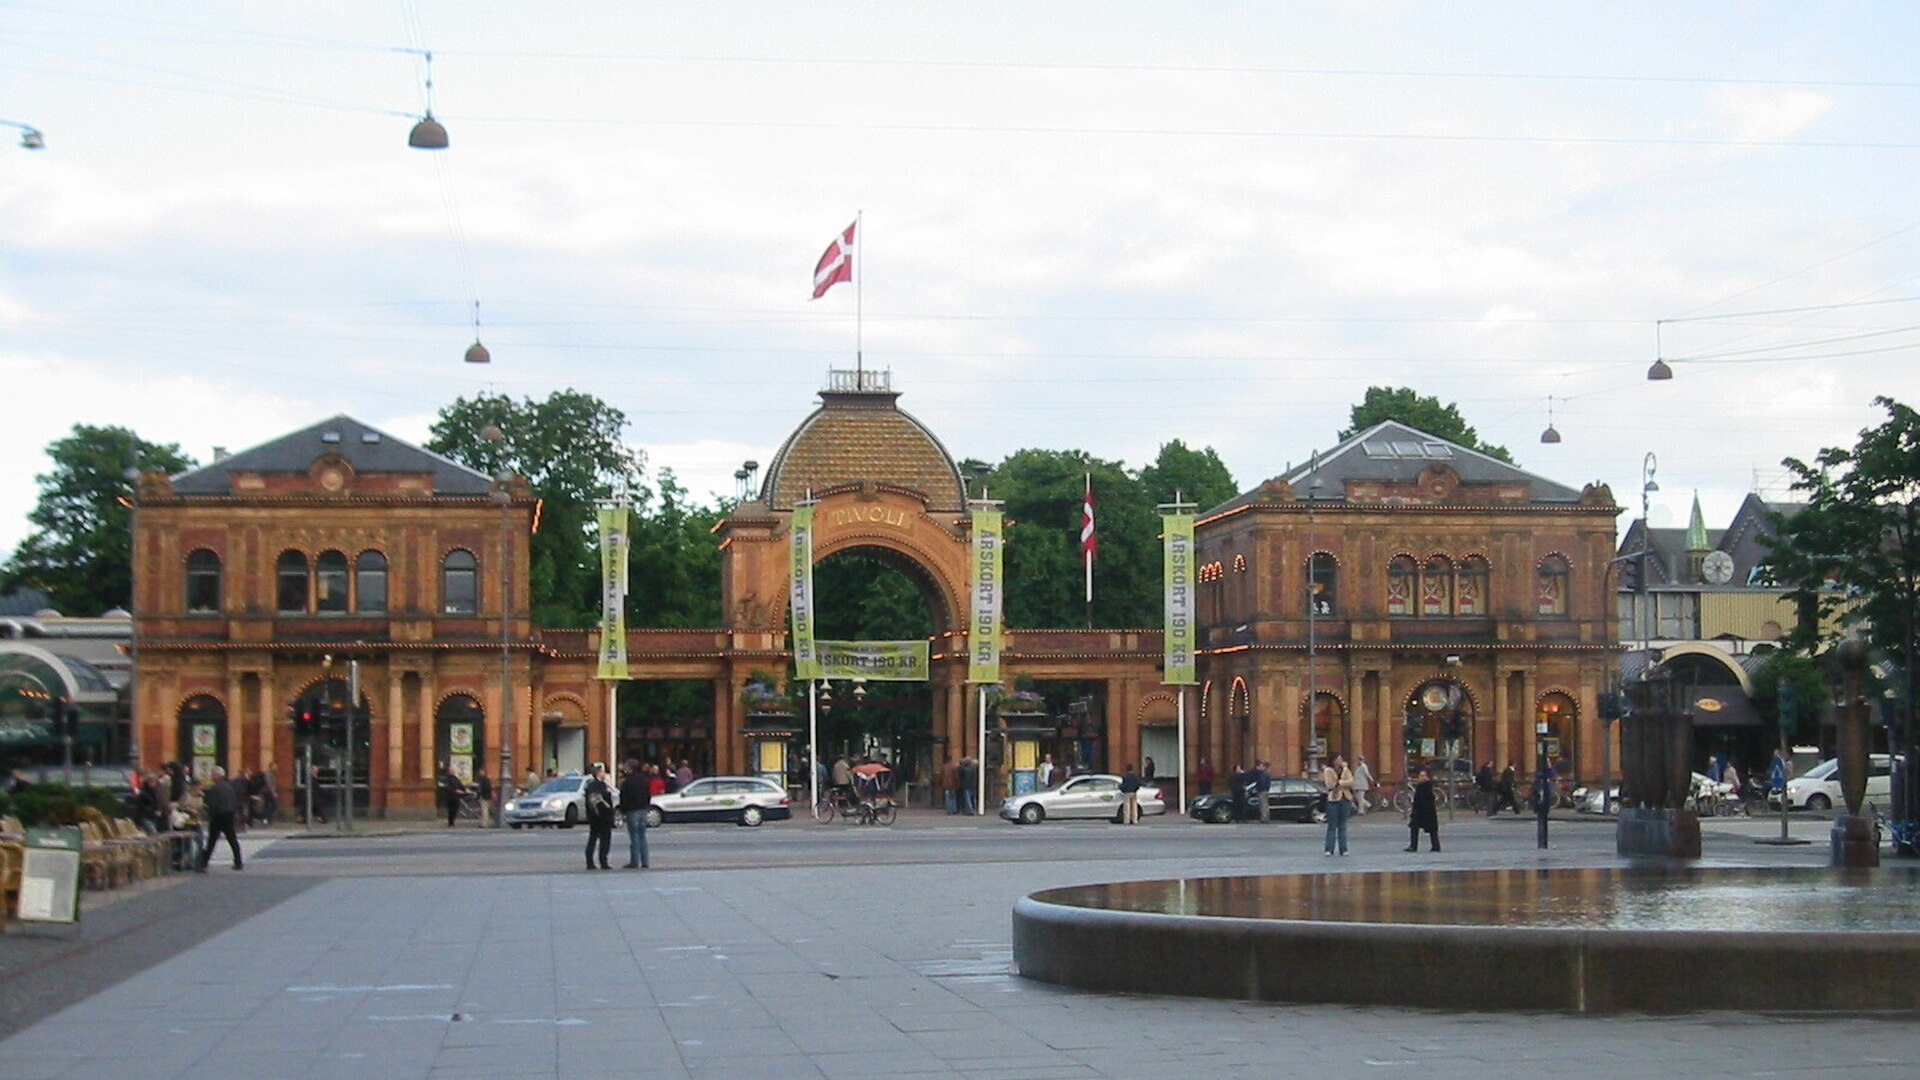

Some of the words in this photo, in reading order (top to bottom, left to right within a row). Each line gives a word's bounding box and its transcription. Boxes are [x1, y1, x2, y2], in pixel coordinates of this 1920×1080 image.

[832, 506, 904, 526] TIVOLI
[978, 610, 993, 636] 190
[1172, 612, 1187, 638] 190
